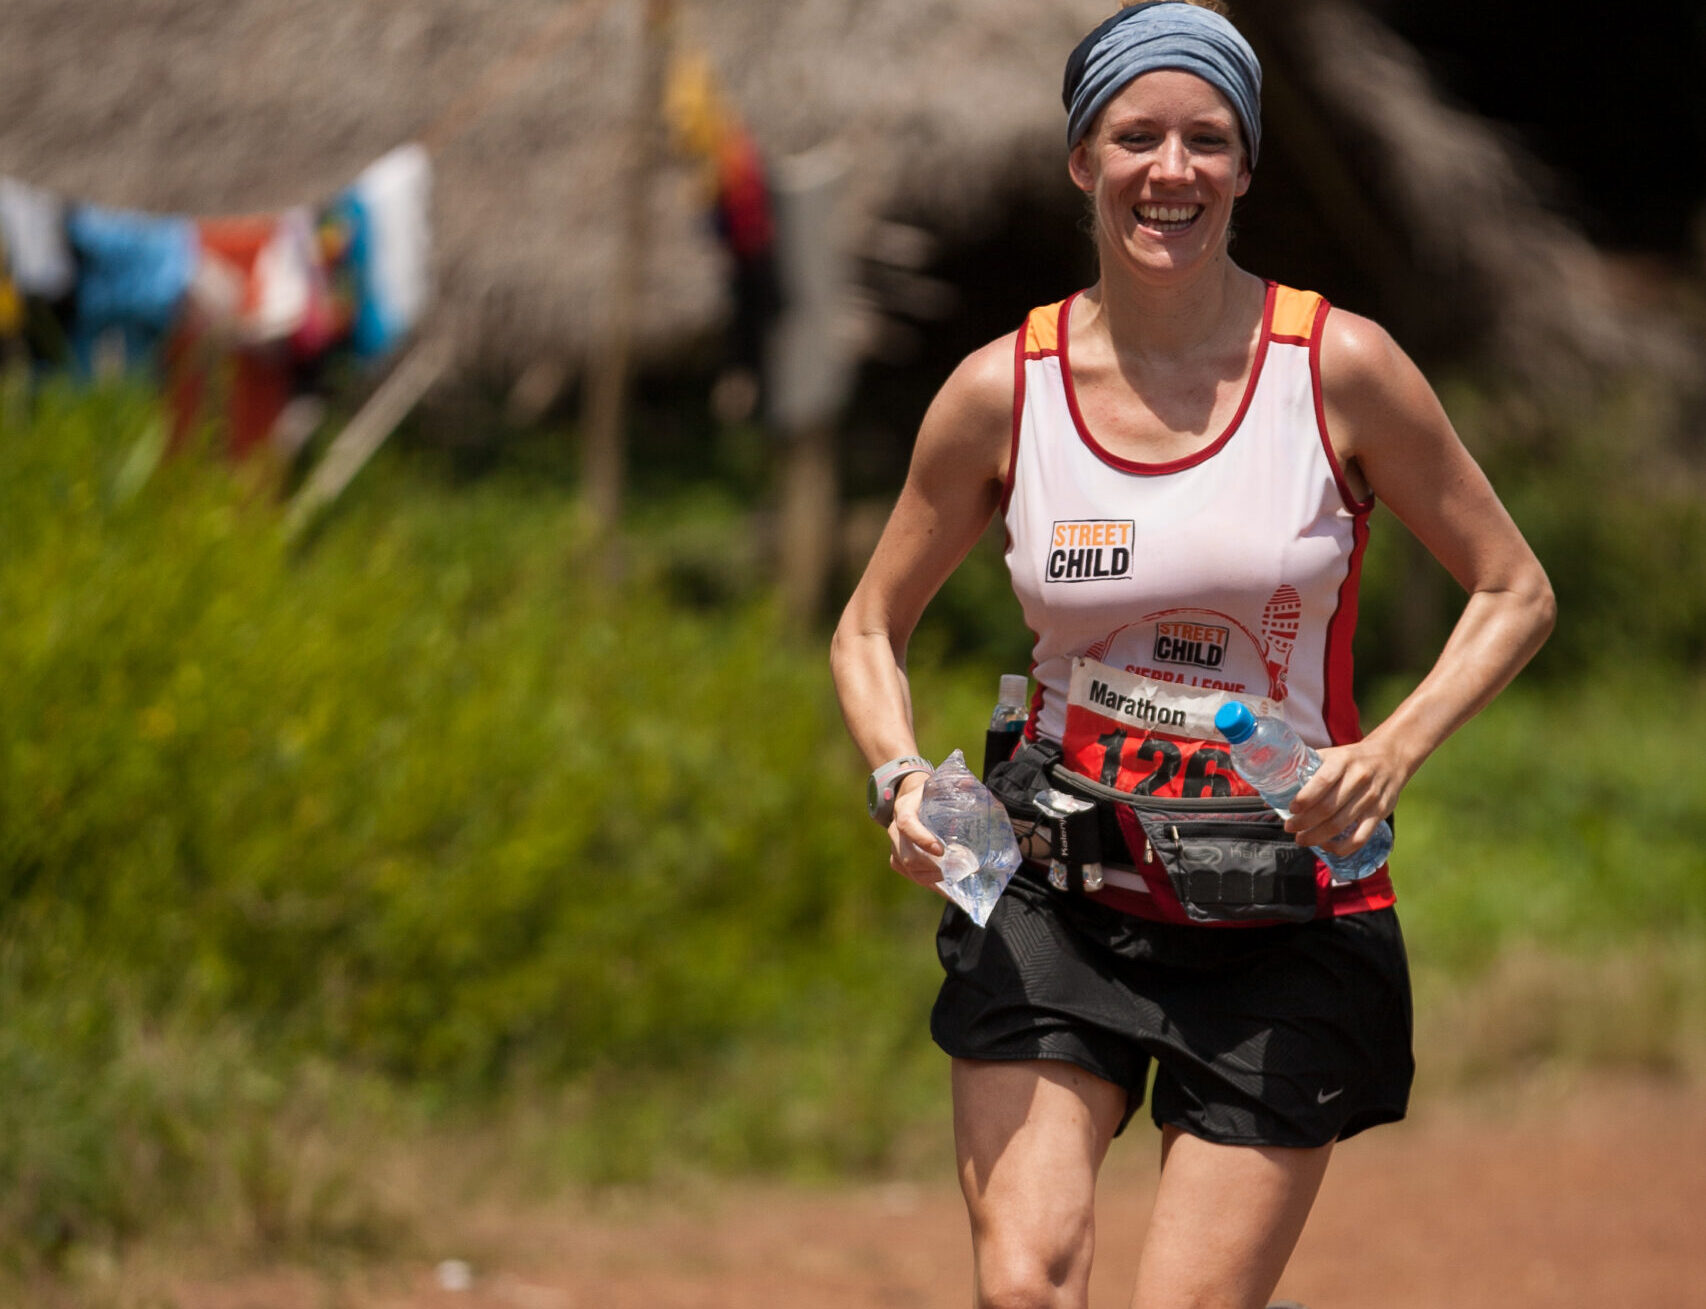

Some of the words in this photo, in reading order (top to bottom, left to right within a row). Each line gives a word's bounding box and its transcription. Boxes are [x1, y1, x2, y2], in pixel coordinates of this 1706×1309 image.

[1054, 523, 1131, 547] STREET
[1049, 547, 1129, 578] CHILD
[1159, 623, 1226, 644] STREET
[1157, 636, 1222, 667] CHILD
[1089, 679, 1187, 727] Marathon
[1097, 727, 1233, 799] 126
